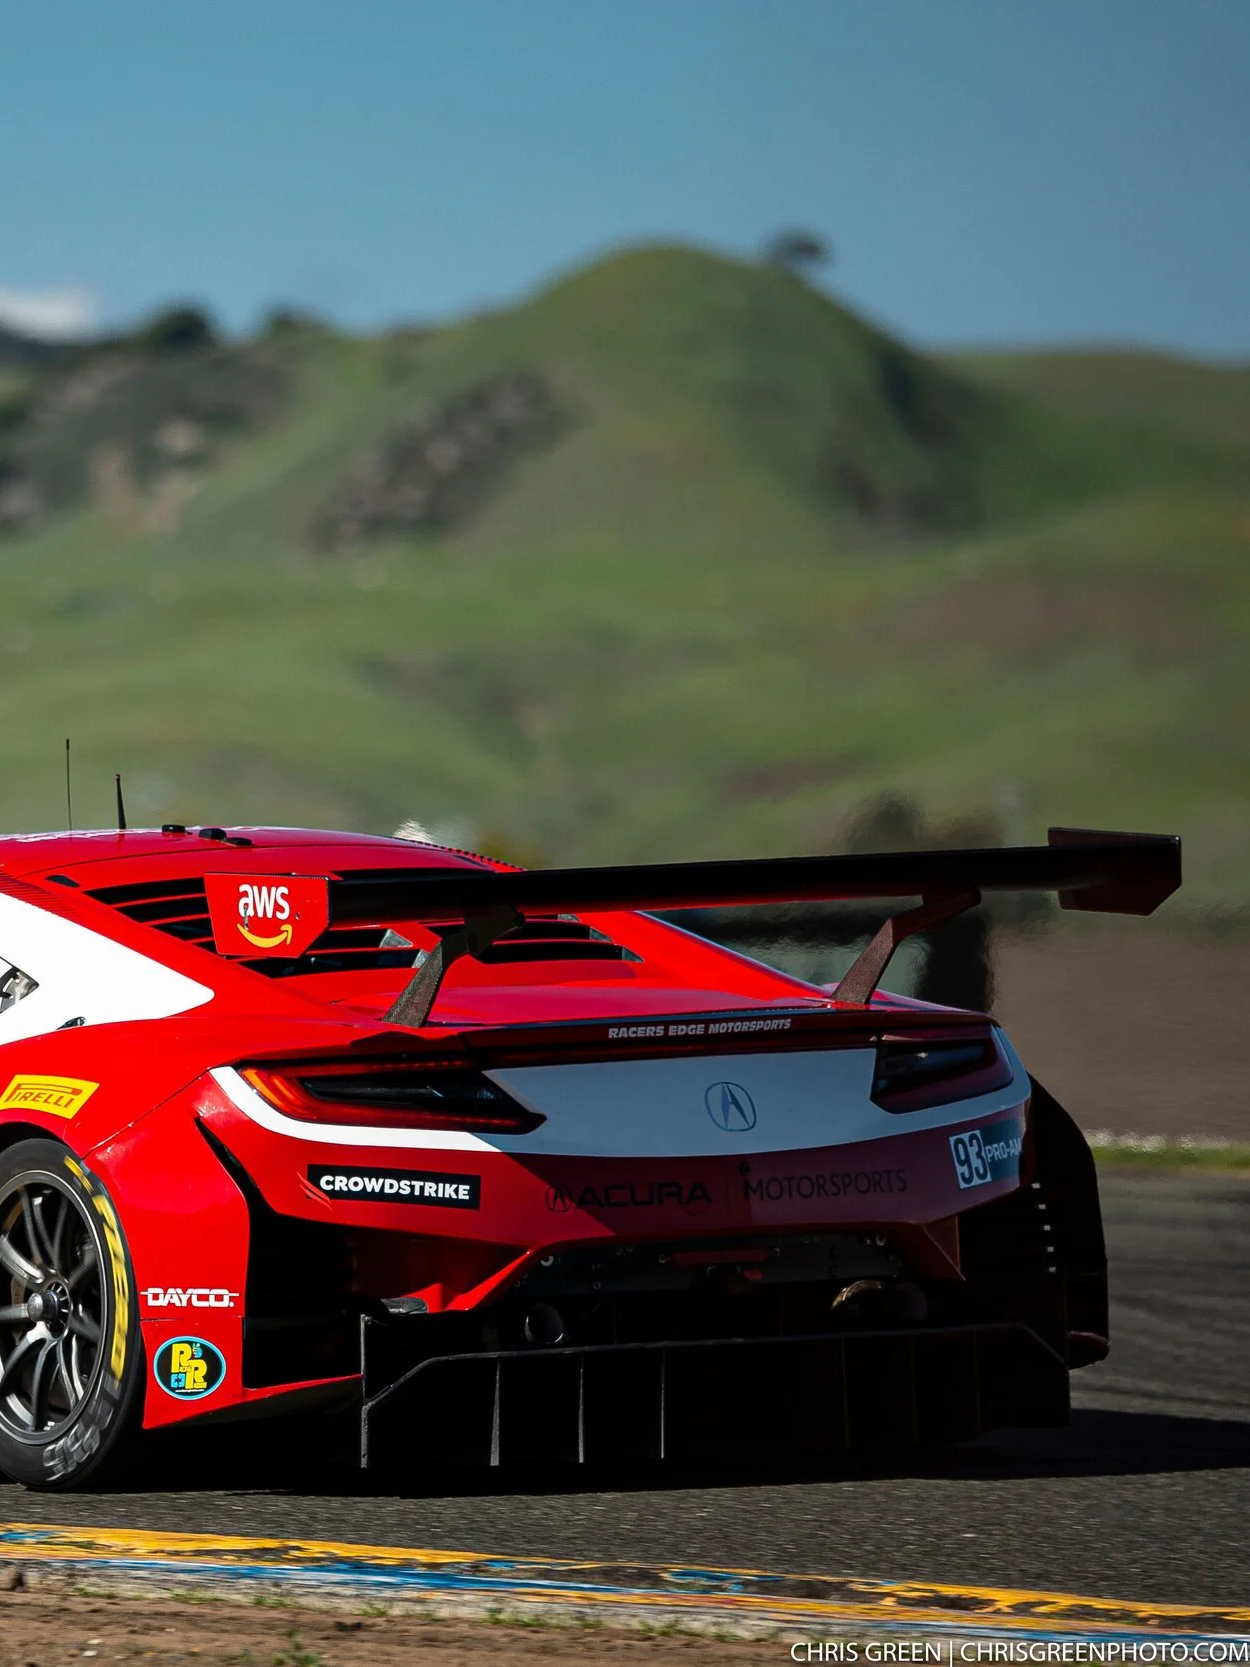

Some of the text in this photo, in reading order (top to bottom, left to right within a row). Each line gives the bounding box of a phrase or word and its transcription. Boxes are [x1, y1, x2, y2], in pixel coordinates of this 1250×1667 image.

[238, 884, 290, 920] aws
[608, 1018, 791, 1039] RACERS EDGE MOTORSPORTS
[4, 1083, 83, 1108] PIRELLI
[953, 1132, 988, 1185] 93
[319, 1174, 470, 1200] CROWDSTRIKE
[576, 1168, 908, 1209] ACURA MOTORSPORTS
